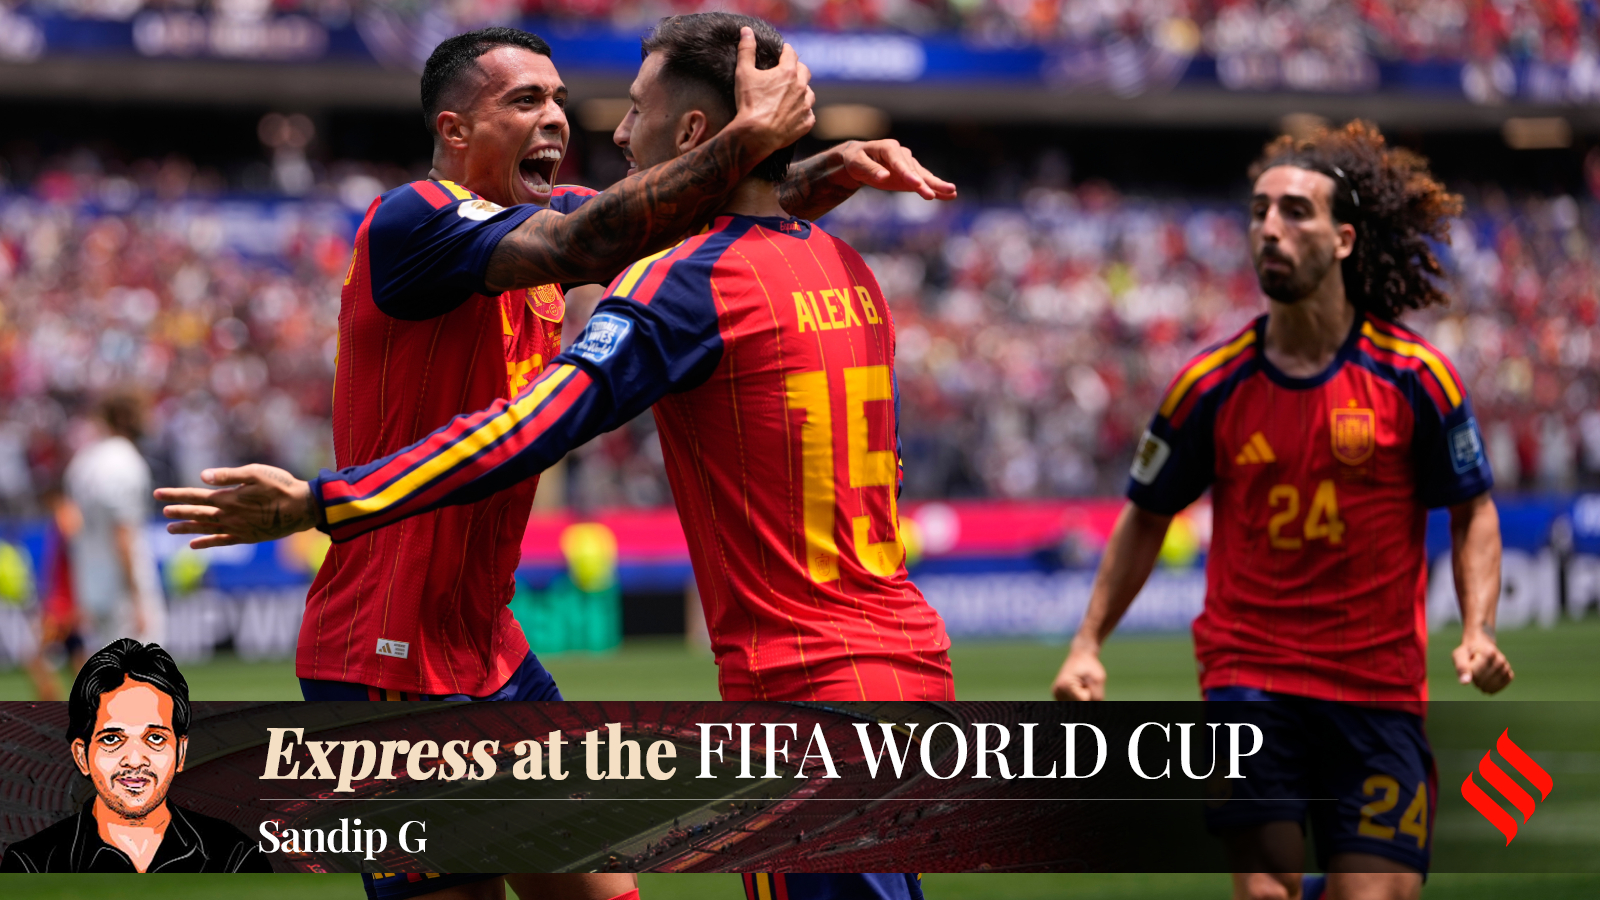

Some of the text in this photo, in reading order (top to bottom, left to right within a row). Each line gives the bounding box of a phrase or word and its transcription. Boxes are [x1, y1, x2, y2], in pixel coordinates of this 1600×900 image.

[792, 286, 883, 333] ALEX B.
[785, 365, 904, 583] 15
[1268, 480, 1344, 548] 24
[1358, 774, 1428, 850] 24
